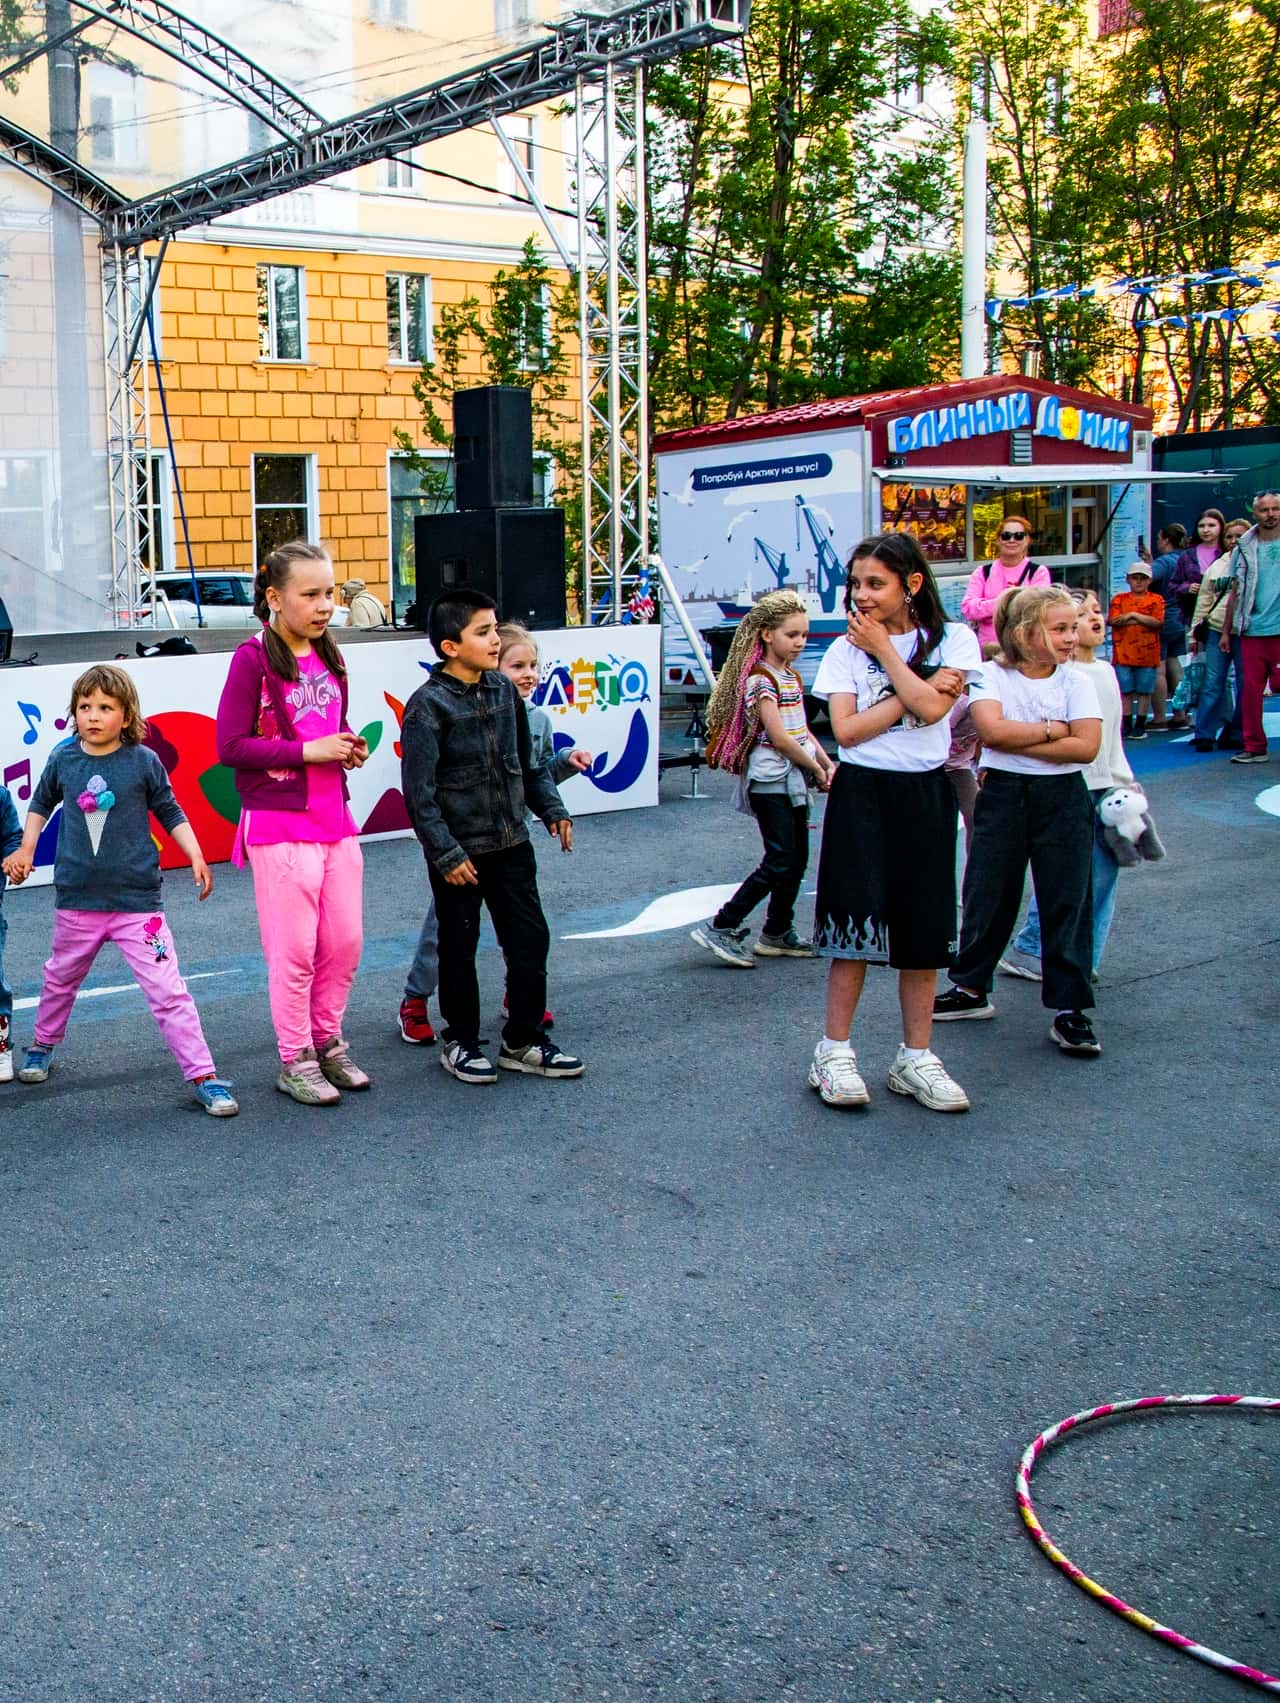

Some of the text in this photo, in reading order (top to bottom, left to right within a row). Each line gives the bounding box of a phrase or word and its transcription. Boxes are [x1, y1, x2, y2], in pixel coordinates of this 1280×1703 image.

[887, 392, 1032, 452] БЛИННЫЙ
[701, 461, 819, 484] Попробуй Арктику на вкус!
[544, 668, 645, 706] ЛЕТО
